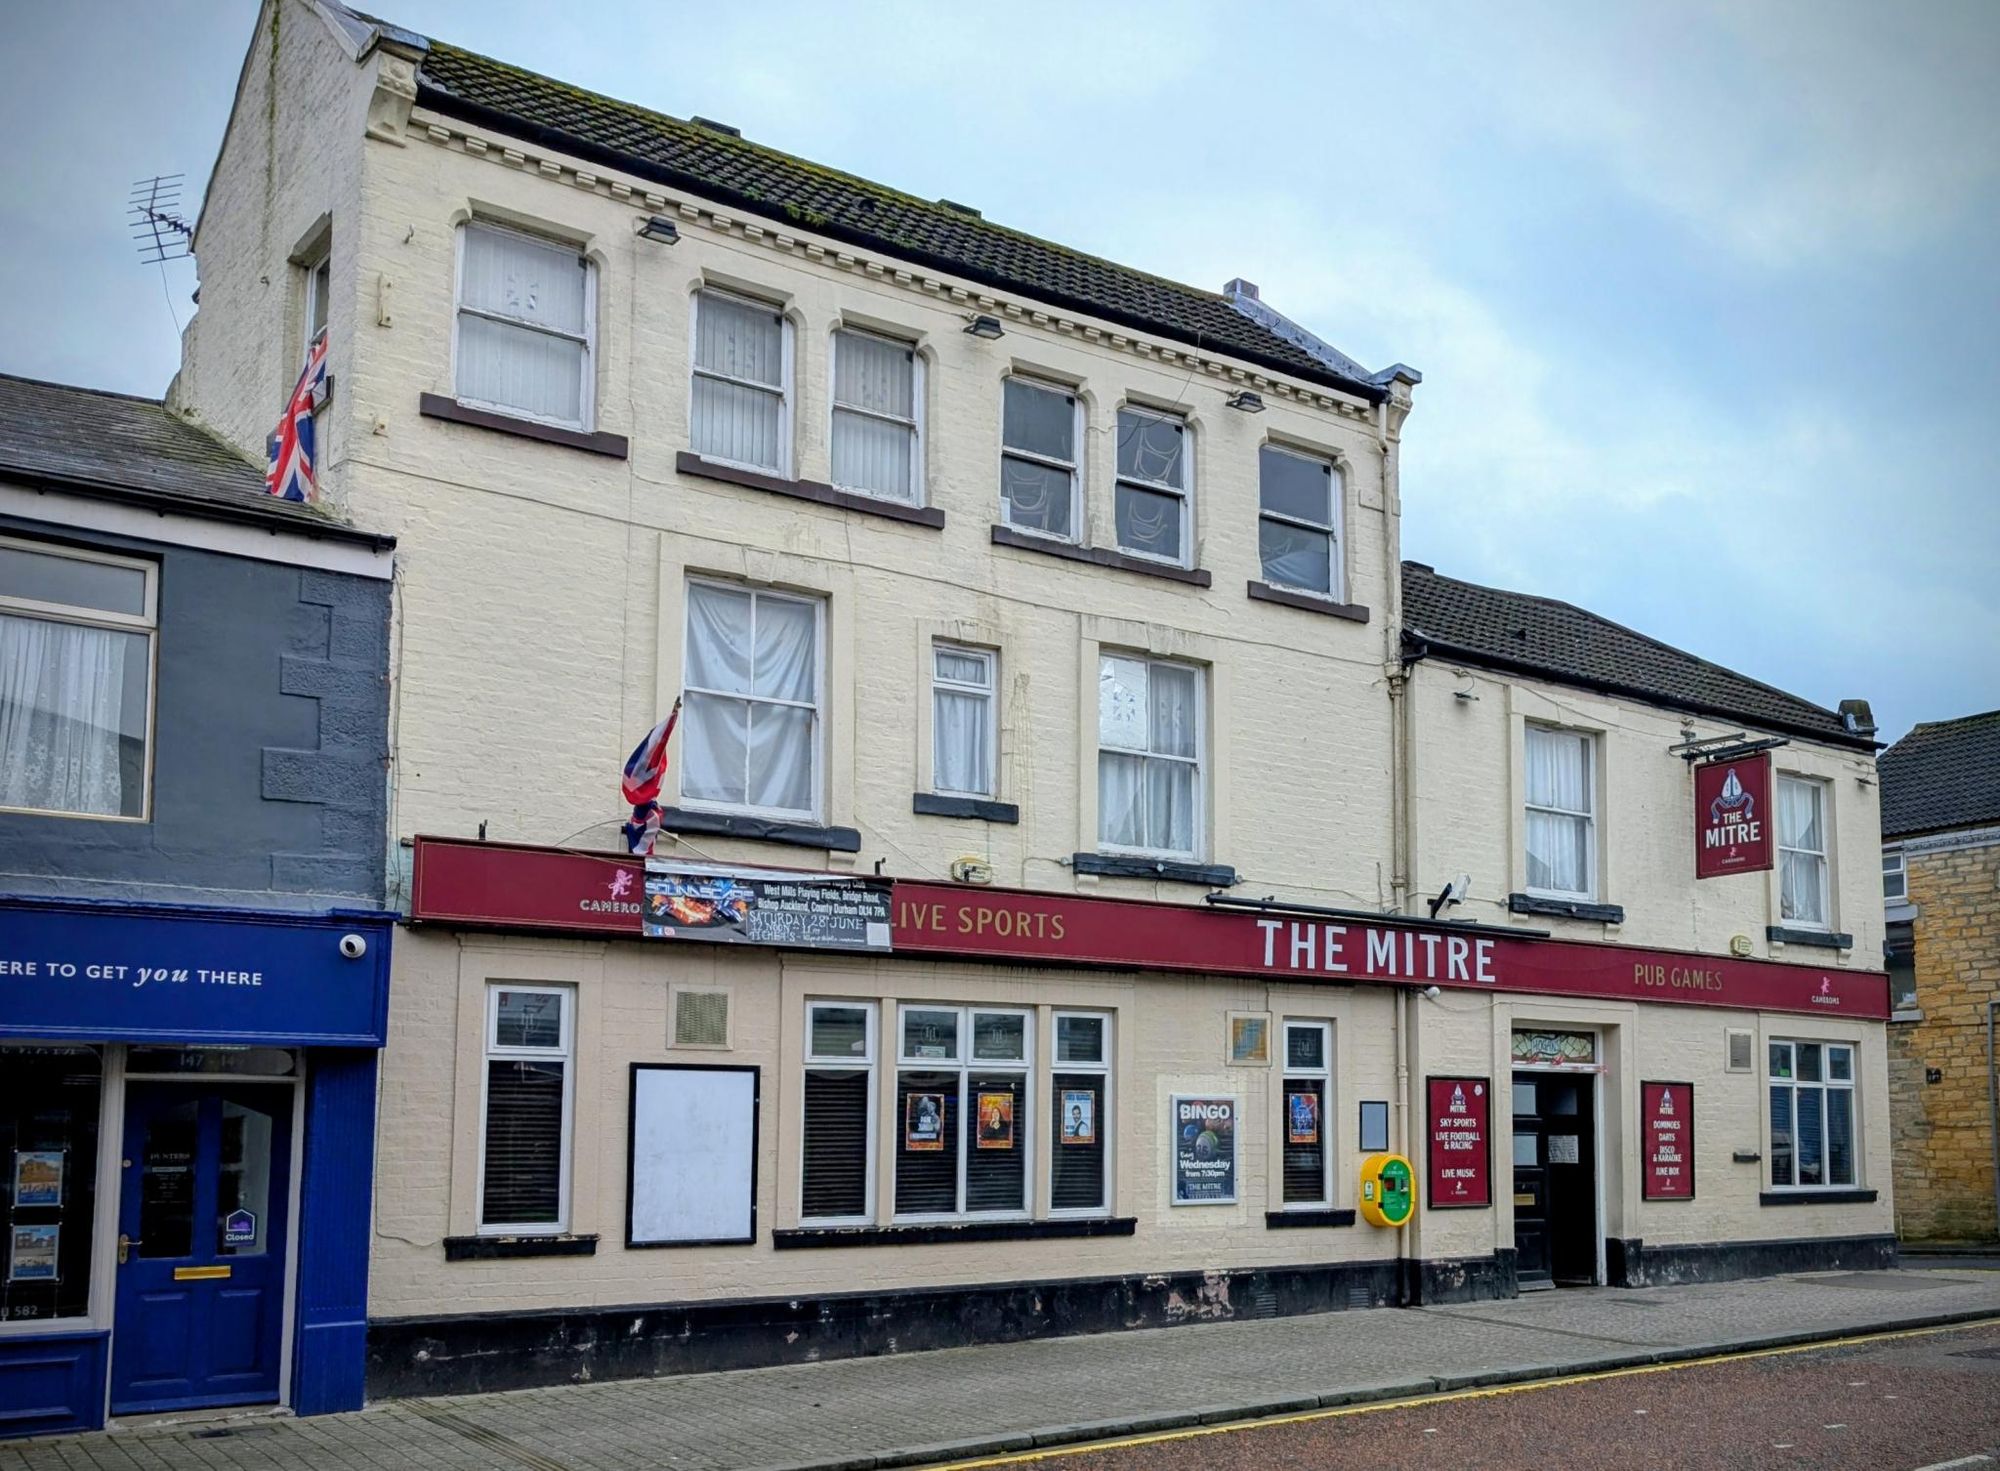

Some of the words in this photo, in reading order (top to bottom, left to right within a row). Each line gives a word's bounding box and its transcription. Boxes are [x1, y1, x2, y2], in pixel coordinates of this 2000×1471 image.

[1722, 811, 1742, 825] THE
[1705, 821, 1761, 849] MITRE
[764, 884, 780, 896] West
[781, 885, 796, 897] Mills
[798, 886, 820, 901] Playing
[842, 890, 862, 904] Bridge
[579, 899, 643, 914] CAMERO
[758, 898, 778, 911] Bishop
[811, 902, 833, 915] County
[834, 903, 858, 916] Durham
[859, 905, 872, 916] DL14
[874, 907, 885, 917] 7PA
[749, 911, 806, 926] SATURDAY
[829, 917, 864, 930] JUNE
[958, 907, 1065, 940] SPORTS
[765, 922, 790, 933] NOON
[1257, 919, 1348, 972] THE
[1366, 929, 1496, 983] MITRE
[46, 963, 76, 977] TO
[86, 965, 129, 980] GET
[133, 967, 189, 987] you
[197, 970, 262, 986] THERE
[1634, 963, 1666, 987] PUB
[1671, 967, 1723, 991] GAMES
[180, 1054, 204, 1066] 147
[1180, 1103, 1230, 1120] BINGO
[1449, 1105, 1467, 1113] MITRE
[1659, 1107, 1674, 1115] MITRE
[1440, 1118, 1451, 1127] SKY
[1453, 1118, 1476, 1127] SPORTS
[1653, 1120, 1680, 1129] DOMINOES
[1435, 1132, 1449, 1141] LIVE
[1450, 1132, 1480, 1141] FOOTBALL
[1658, 1133, 1675, 1141] DARTS
[1444, 1141, 1449, 1150] &
[1451, 1141, 1473, 1150] RACING
[1659, 1145, 1675, 1154] DISCO
[1653, 1154, 1657, 1162] &
[1658, 1154, 1682, 1162] KARAOKE
[1180, 1160, 1231, 1170] Wednesday
[1185, 1170, 1200, 1178] from
[1201, 1170, 1225, 1178] 7:30pm
[1442, 1169, 1455, 1178] LIVE
[1456, 1169, 1475, 1178] MUSIC
[1656, 1167, 1668, 1175] JUKE
[1669, 1167, 1680, 1175] BOX
[225, 1233, 254, 1241] Closed
[15, 1304, 38, 1317] 582
